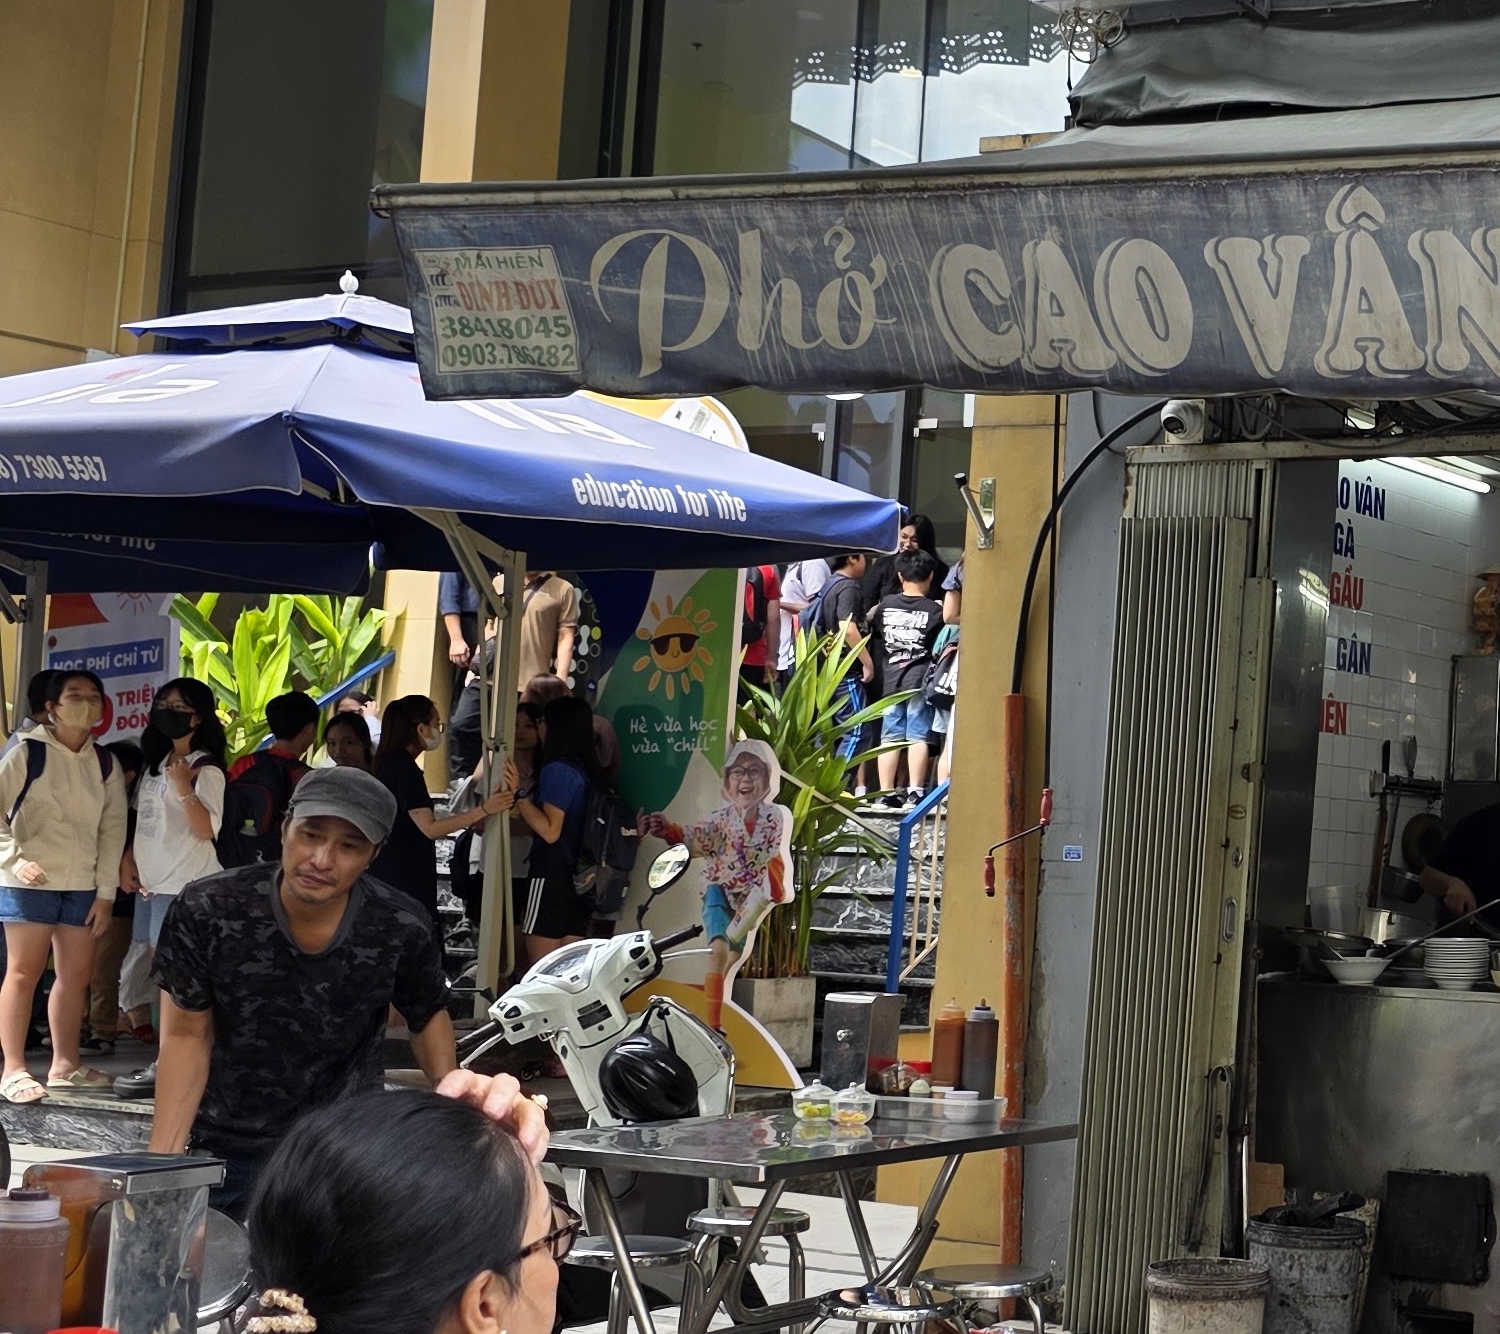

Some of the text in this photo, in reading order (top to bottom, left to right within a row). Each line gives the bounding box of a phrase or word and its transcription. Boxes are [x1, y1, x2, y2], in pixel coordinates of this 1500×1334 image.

[495, 252, 544, 270] HIÊN
[590, 221, 896, 378] Phở
[930, 224, 1193, 378] CAO
[440, 315, 572, 340] 38418045
[442, 342, 575, 367] 0903.786282
[14, 454, 64, 480] 7300
[61, 455, 107, 482] 5587
[571, 472, 747, 522] education for life
[1355, 476, 1386, 521] VÂN
[1333, 518, 1355, 559] GÀ
[1336, 632, 1372, 675] GÂN
[630, 715, 718, 736] Hè vừa học
[632, 736, 660, 754] vừa
